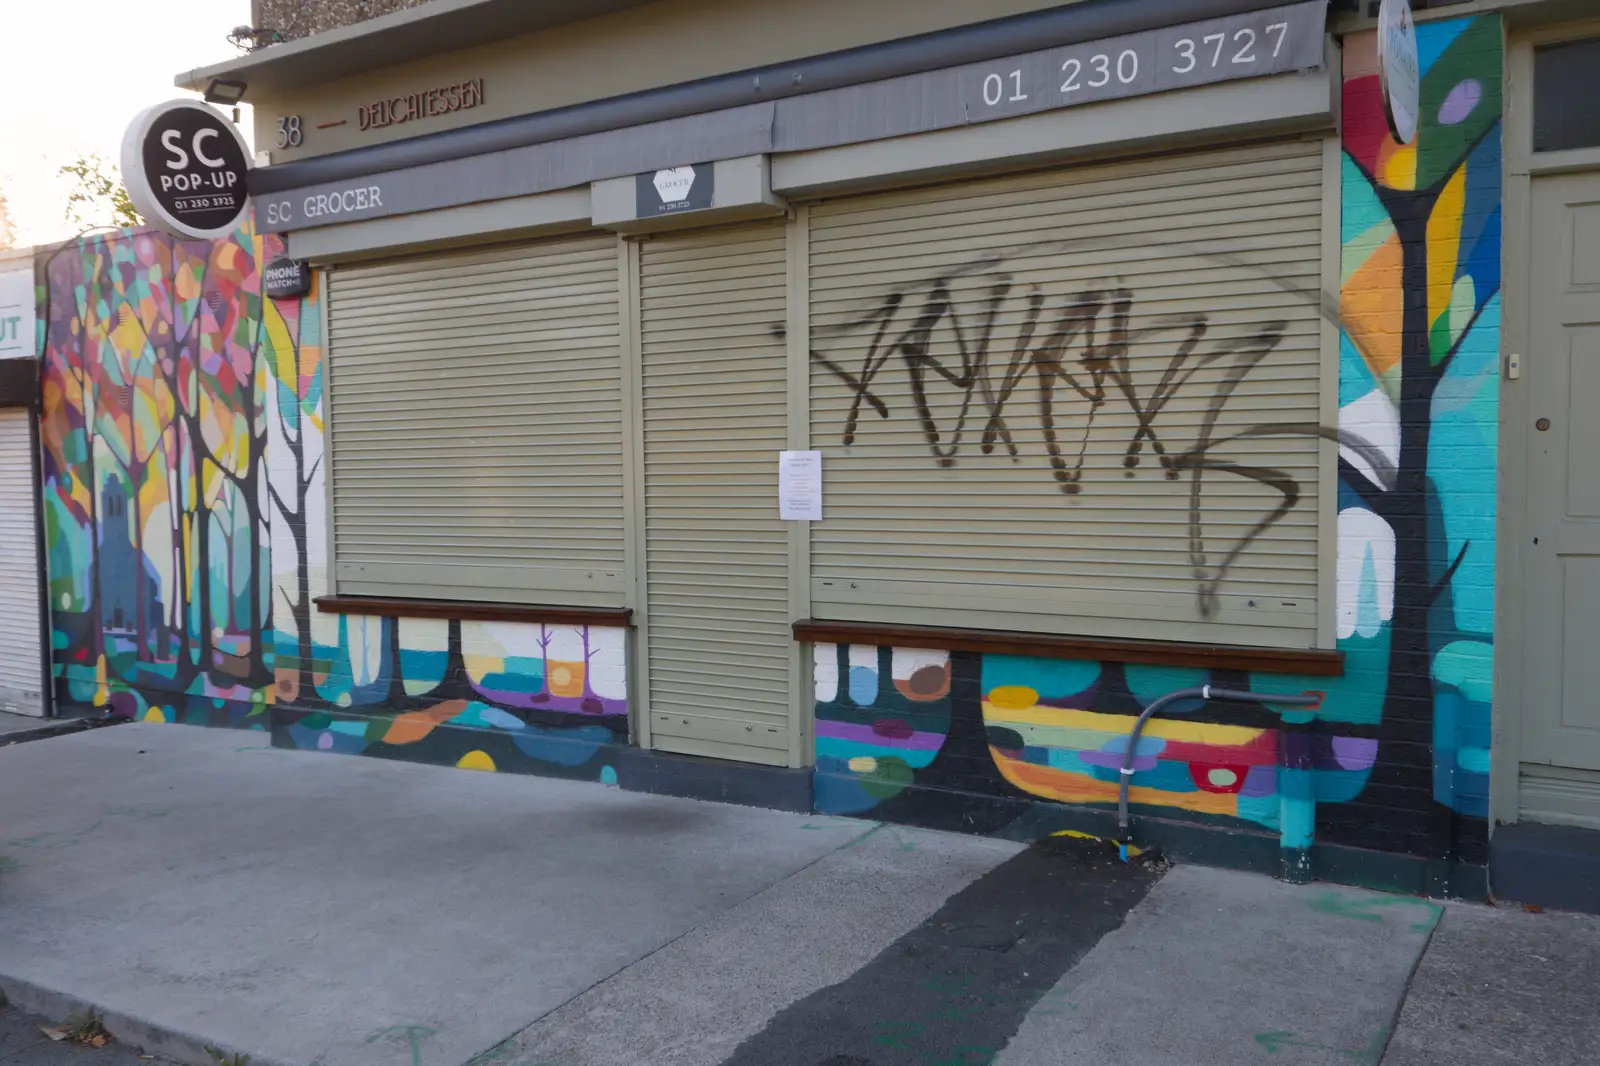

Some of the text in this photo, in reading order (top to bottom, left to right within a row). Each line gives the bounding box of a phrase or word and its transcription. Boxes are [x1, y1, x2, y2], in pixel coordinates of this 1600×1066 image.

[983, 22, 1288, 106] 01 230 3727
[276, 78, 484, 149] 38 DELICATESSEN
[161, 127, 226, 170] SC
[160, 171, 237, 192] POP-UP
[174, 200, 188, 209] 01
[267, 186, 383, 224] SC GROCER
[266, 265, 300, 280] PHONE
